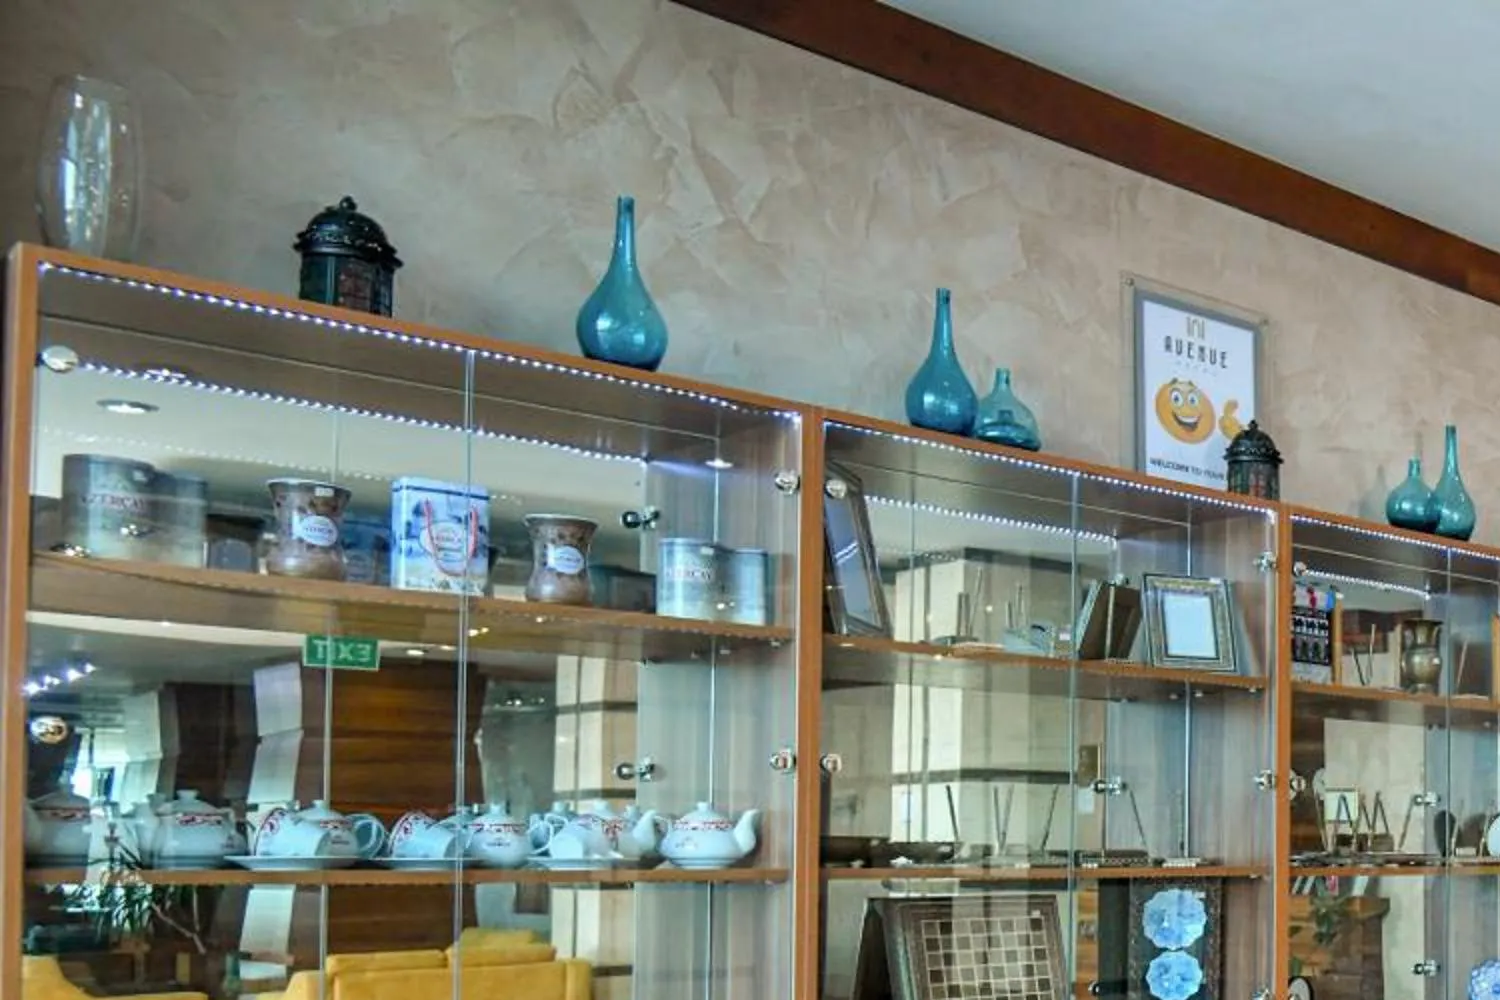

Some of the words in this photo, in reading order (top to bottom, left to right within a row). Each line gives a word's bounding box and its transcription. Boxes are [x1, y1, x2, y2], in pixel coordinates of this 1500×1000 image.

[1164, 335, 1228, 369] AVENUE
[1150, 458, 1189, 473] WELCOME
[1190, 466, 1202, 476] TO
